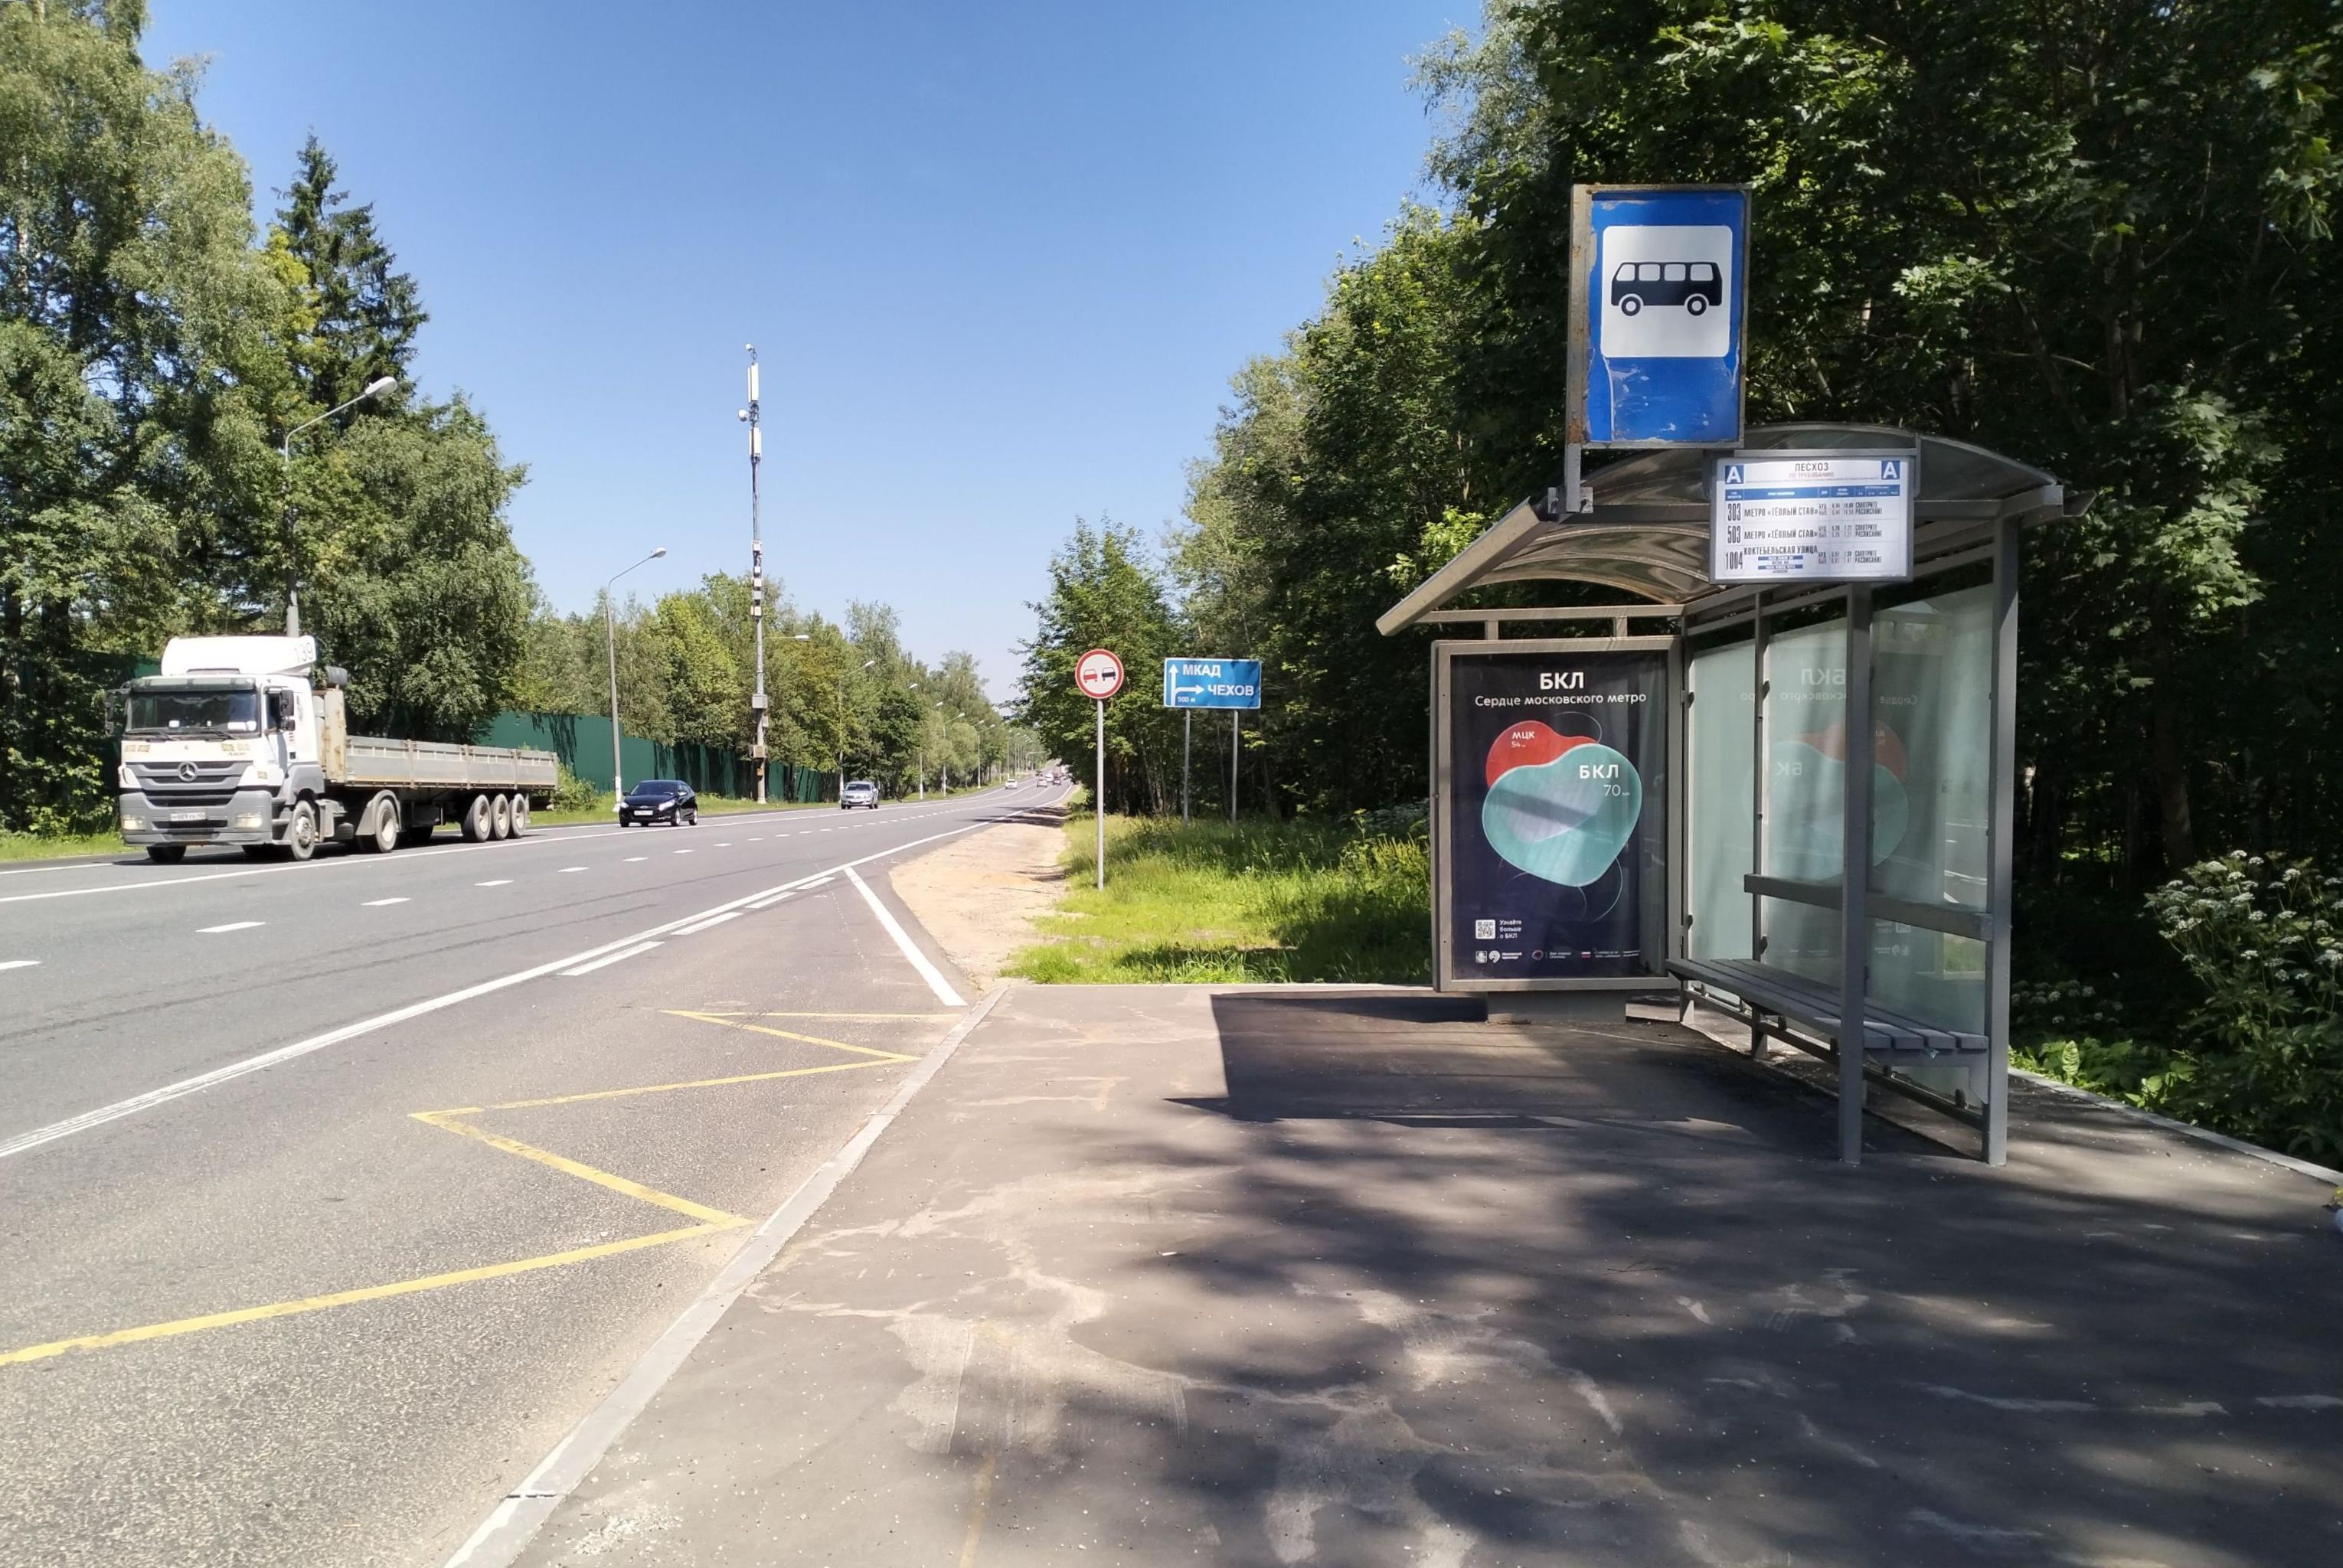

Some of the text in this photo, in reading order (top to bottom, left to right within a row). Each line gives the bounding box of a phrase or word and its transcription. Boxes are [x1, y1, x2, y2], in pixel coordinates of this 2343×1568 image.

[1795, 462, 1828, 472] ЛЕСХОЗ
[1883, 462, 1897, 479] А
[1727, 466, 1742, 483] А
[1727, 503, 1741, 521] 303
[1744, 508, 1766, 517] МЕТРО
[1727, 525, 1741, 544] 503
[1744, 531, 1766, 539] МЕТРО
[1743, 545, 1819, 555] КОКТЕБЕЛЬСКАЯ УЛИЦА
[1725, 551, 1743, 570] 1004
[1183, 664, 1221, 678] МКАД
[1540, 671, 1585, 691] БКЛ
[1207, 684, 1254, 696] ЧЕХОВ
[1475, 692, 1647, 708] Сердце московского метро
[1511, 731, 1535, 740] МЦК
[1580, 764, 1619, 779] БКЛ
[1603, 784, 1622, 797] 70
